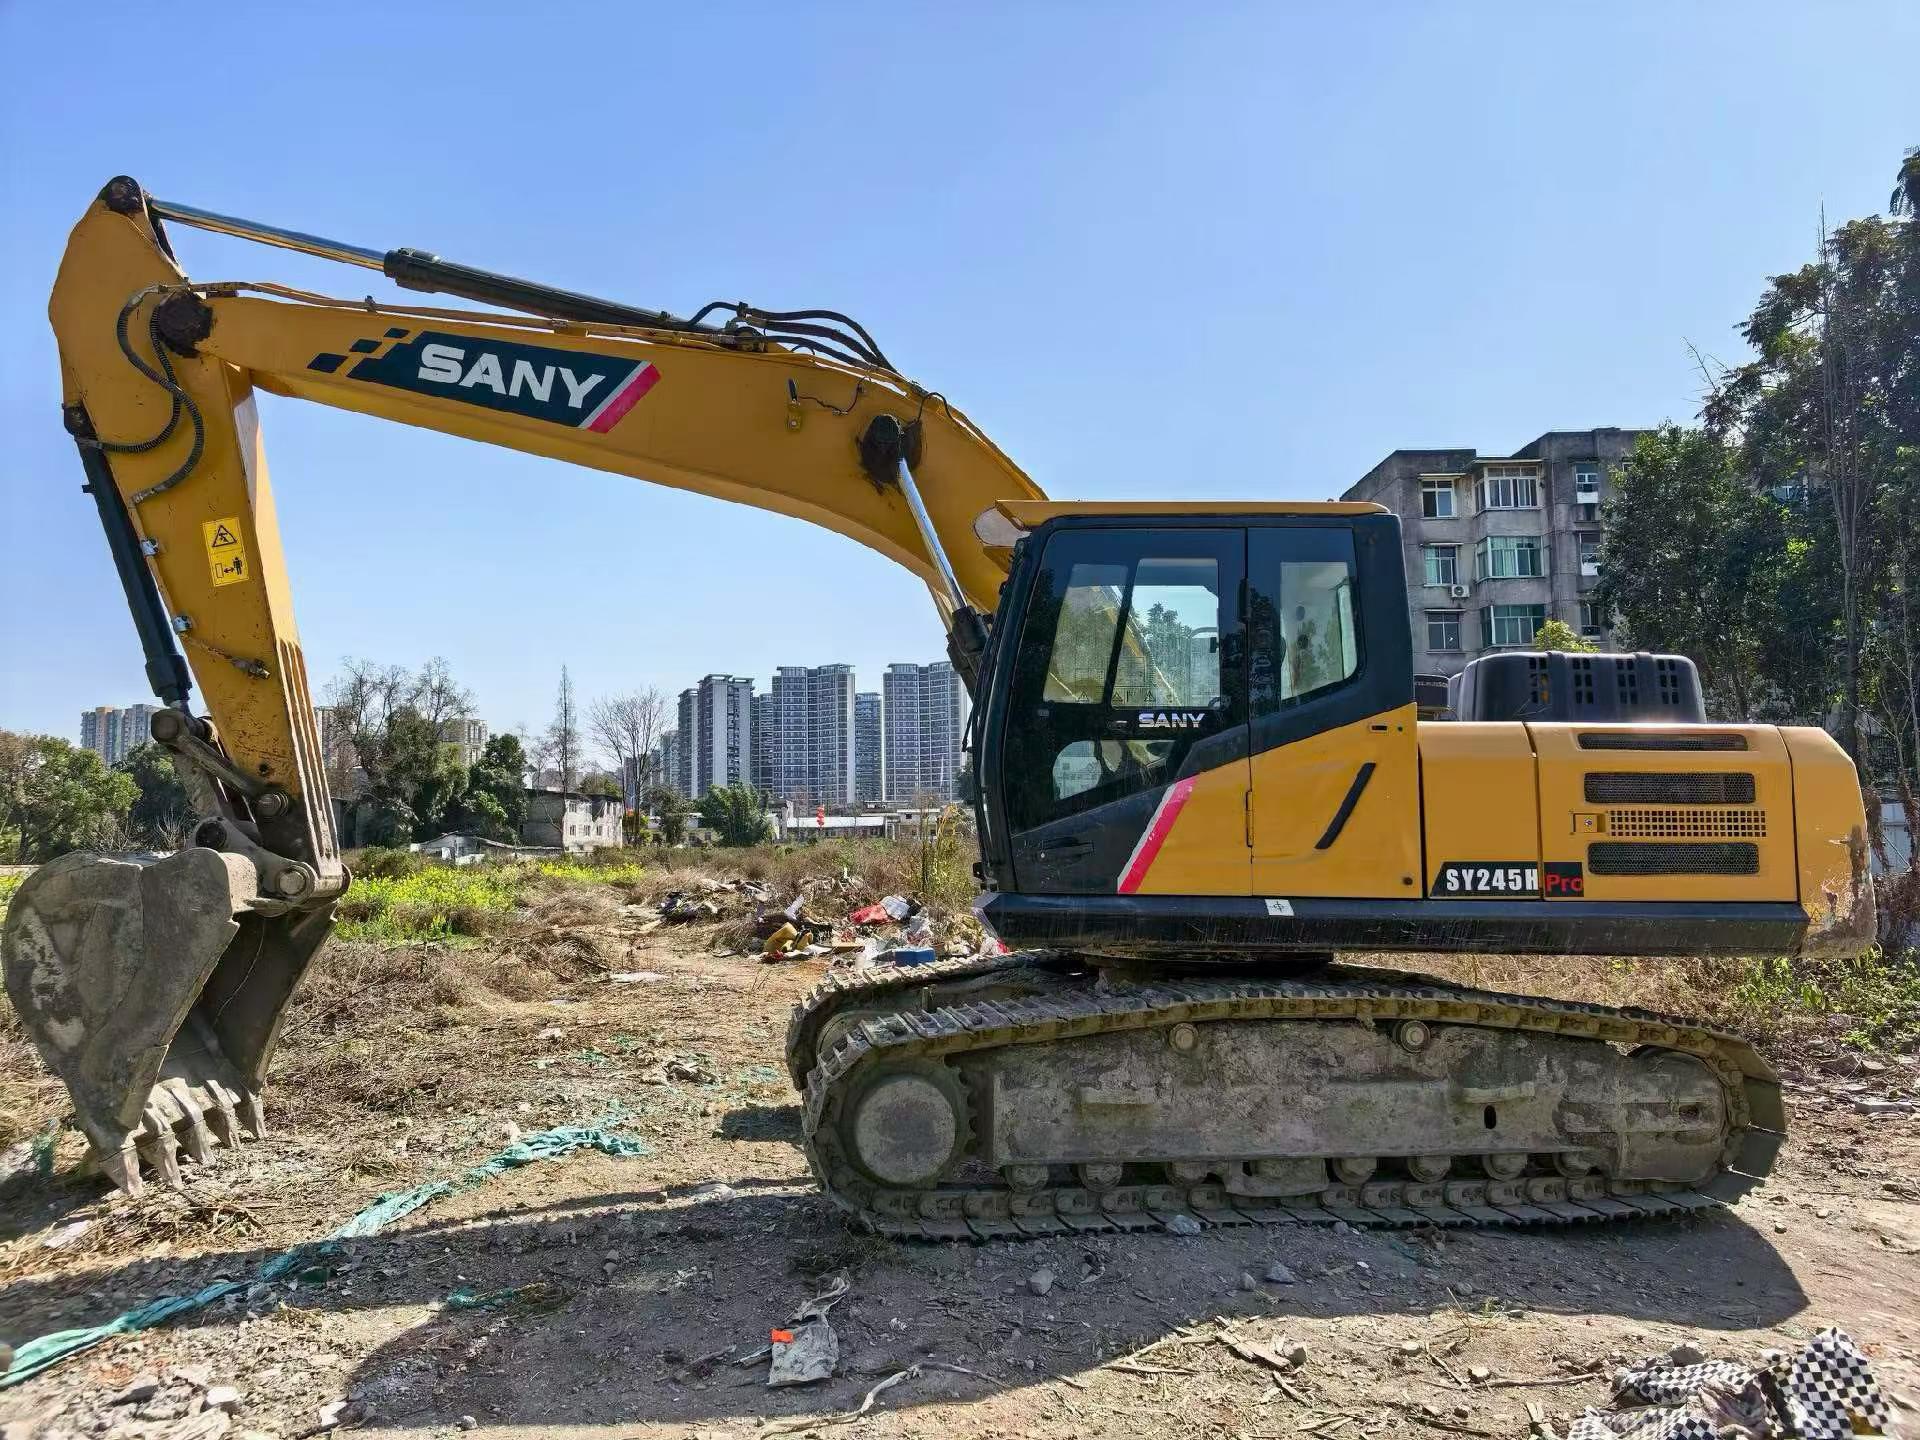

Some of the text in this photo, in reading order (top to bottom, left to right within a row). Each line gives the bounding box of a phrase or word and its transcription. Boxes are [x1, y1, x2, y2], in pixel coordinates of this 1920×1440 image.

[417, 343, 606, 408] SANY
[1138, 713, 1205, 728] SANY
[1446, 868, 1583, 892] SY245H Pro
